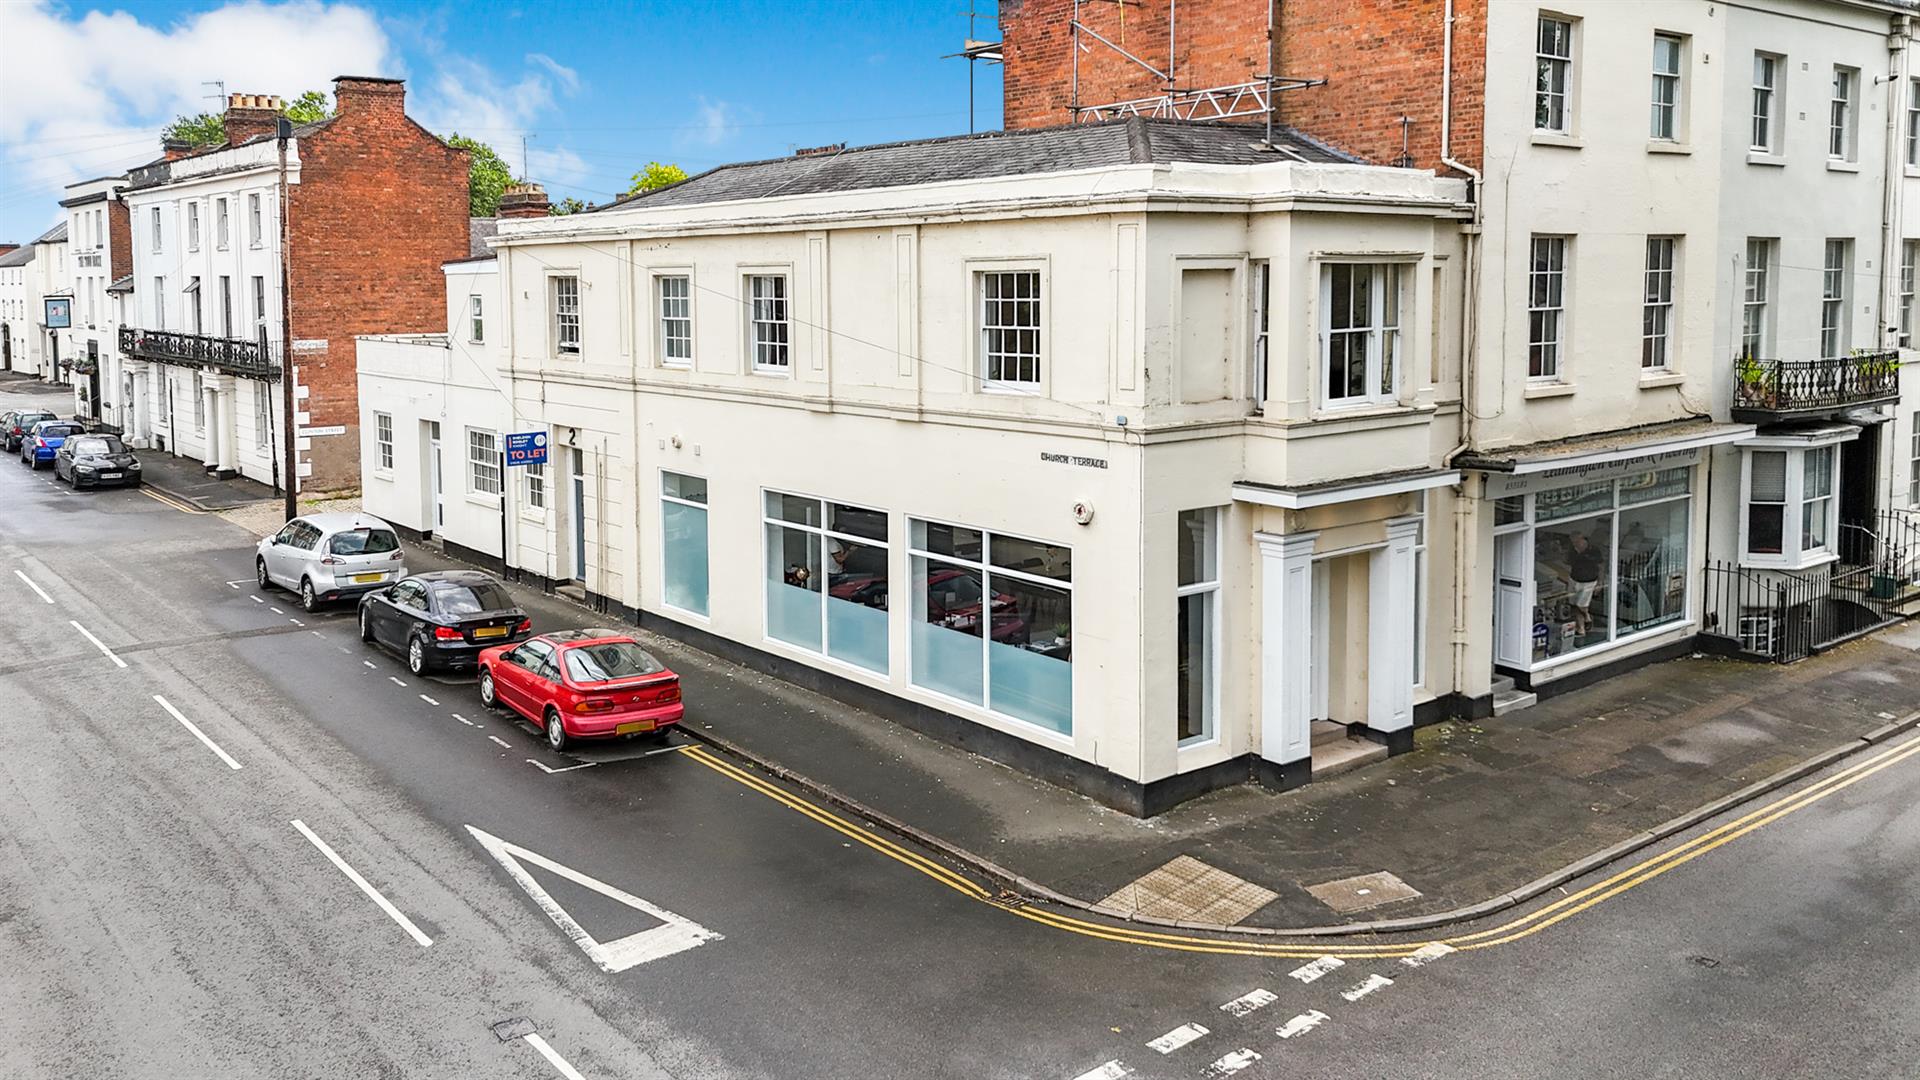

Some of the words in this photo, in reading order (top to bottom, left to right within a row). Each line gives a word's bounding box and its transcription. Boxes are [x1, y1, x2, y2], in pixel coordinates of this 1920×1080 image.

[569, 427, 576, 446] 2
[510, 450, 525, 460] TO
[527, 448, 545, 458] LET
[1040, 452, 1069, 464] CHURCH
[1072, 456, 1105, 469] TERRACE
